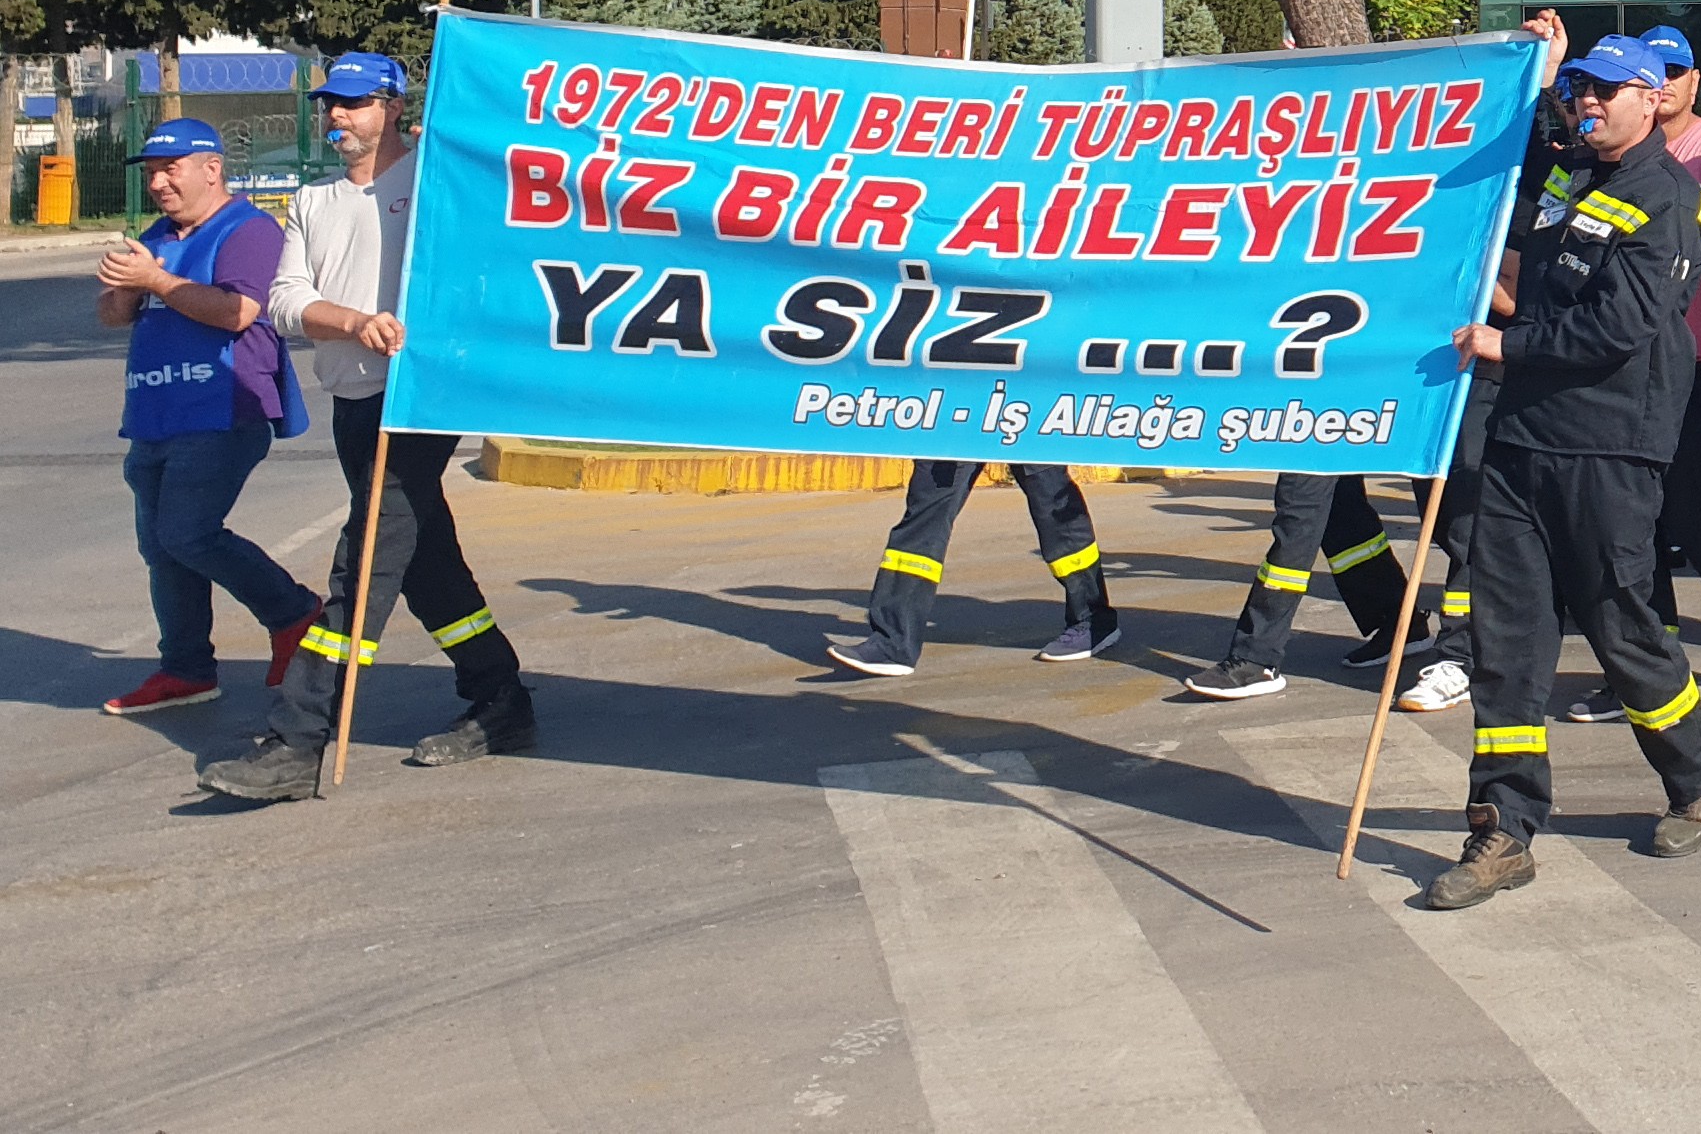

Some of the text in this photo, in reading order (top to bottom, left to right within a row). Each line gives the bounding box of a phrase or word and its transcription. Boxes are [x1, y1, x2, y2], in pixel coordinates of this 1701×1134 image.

[524, 61, 1484, 178] 1972'DEN BERİ TÜPRAŞLIYIZ
[506, 133, 1438, 262] BİZ BİR AİLEYİZ
[533, 259, 717, 357] YA
[761, 259, 1053, 370] SİZ
[793, 383, 944, 431] Petrol
[982, 380, 1031, 445] İş
[1039, 394, 1206, 449] Aliağa
[1218, 399, 1399, 452] şubesi
